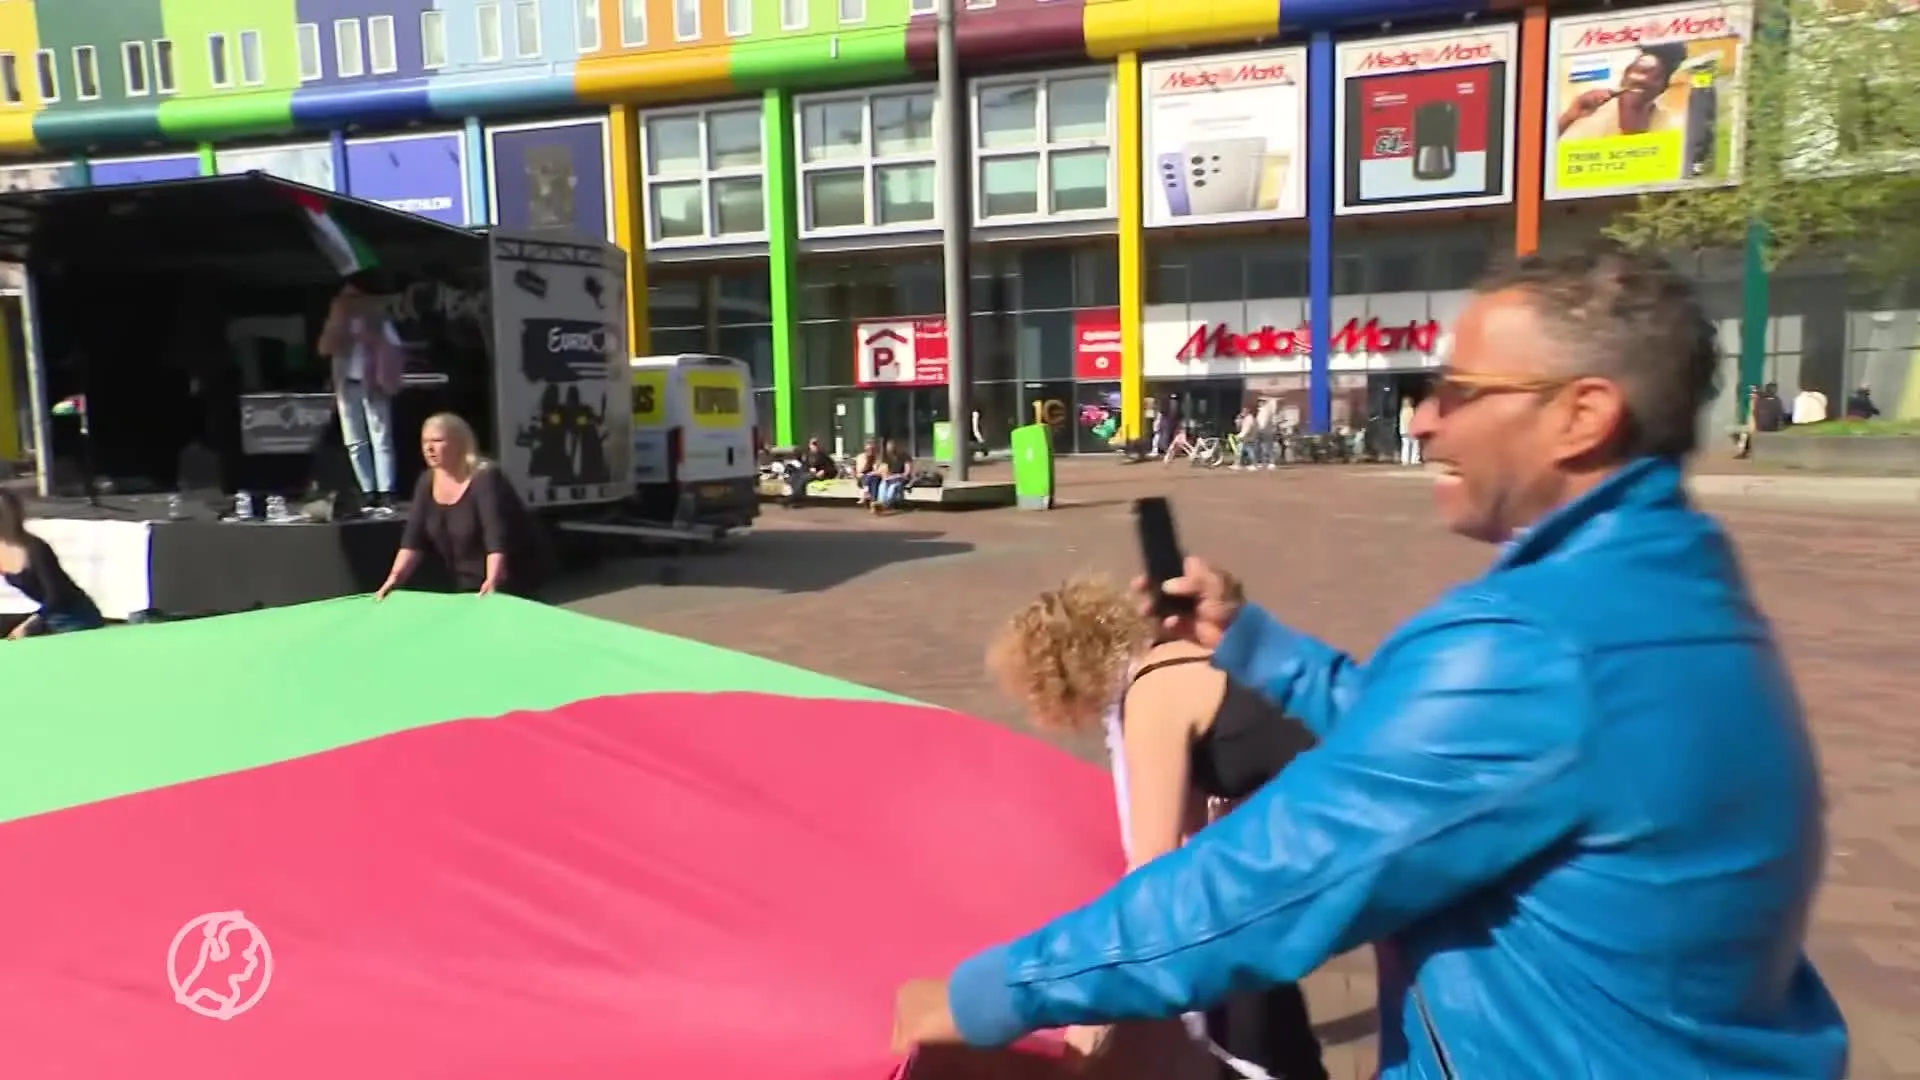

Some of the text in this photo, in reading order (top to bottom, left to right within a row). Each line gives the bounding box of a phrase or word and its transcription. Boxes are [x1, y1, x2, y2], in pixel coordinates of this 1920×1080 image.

[1573, 16, 1728, 47] Media Markt
[1358, 42, 1493, 70] Media Markt
[1160, 64, 1286, 90] Media Markt
[1175, 317, 1441, 362] Media Markt
